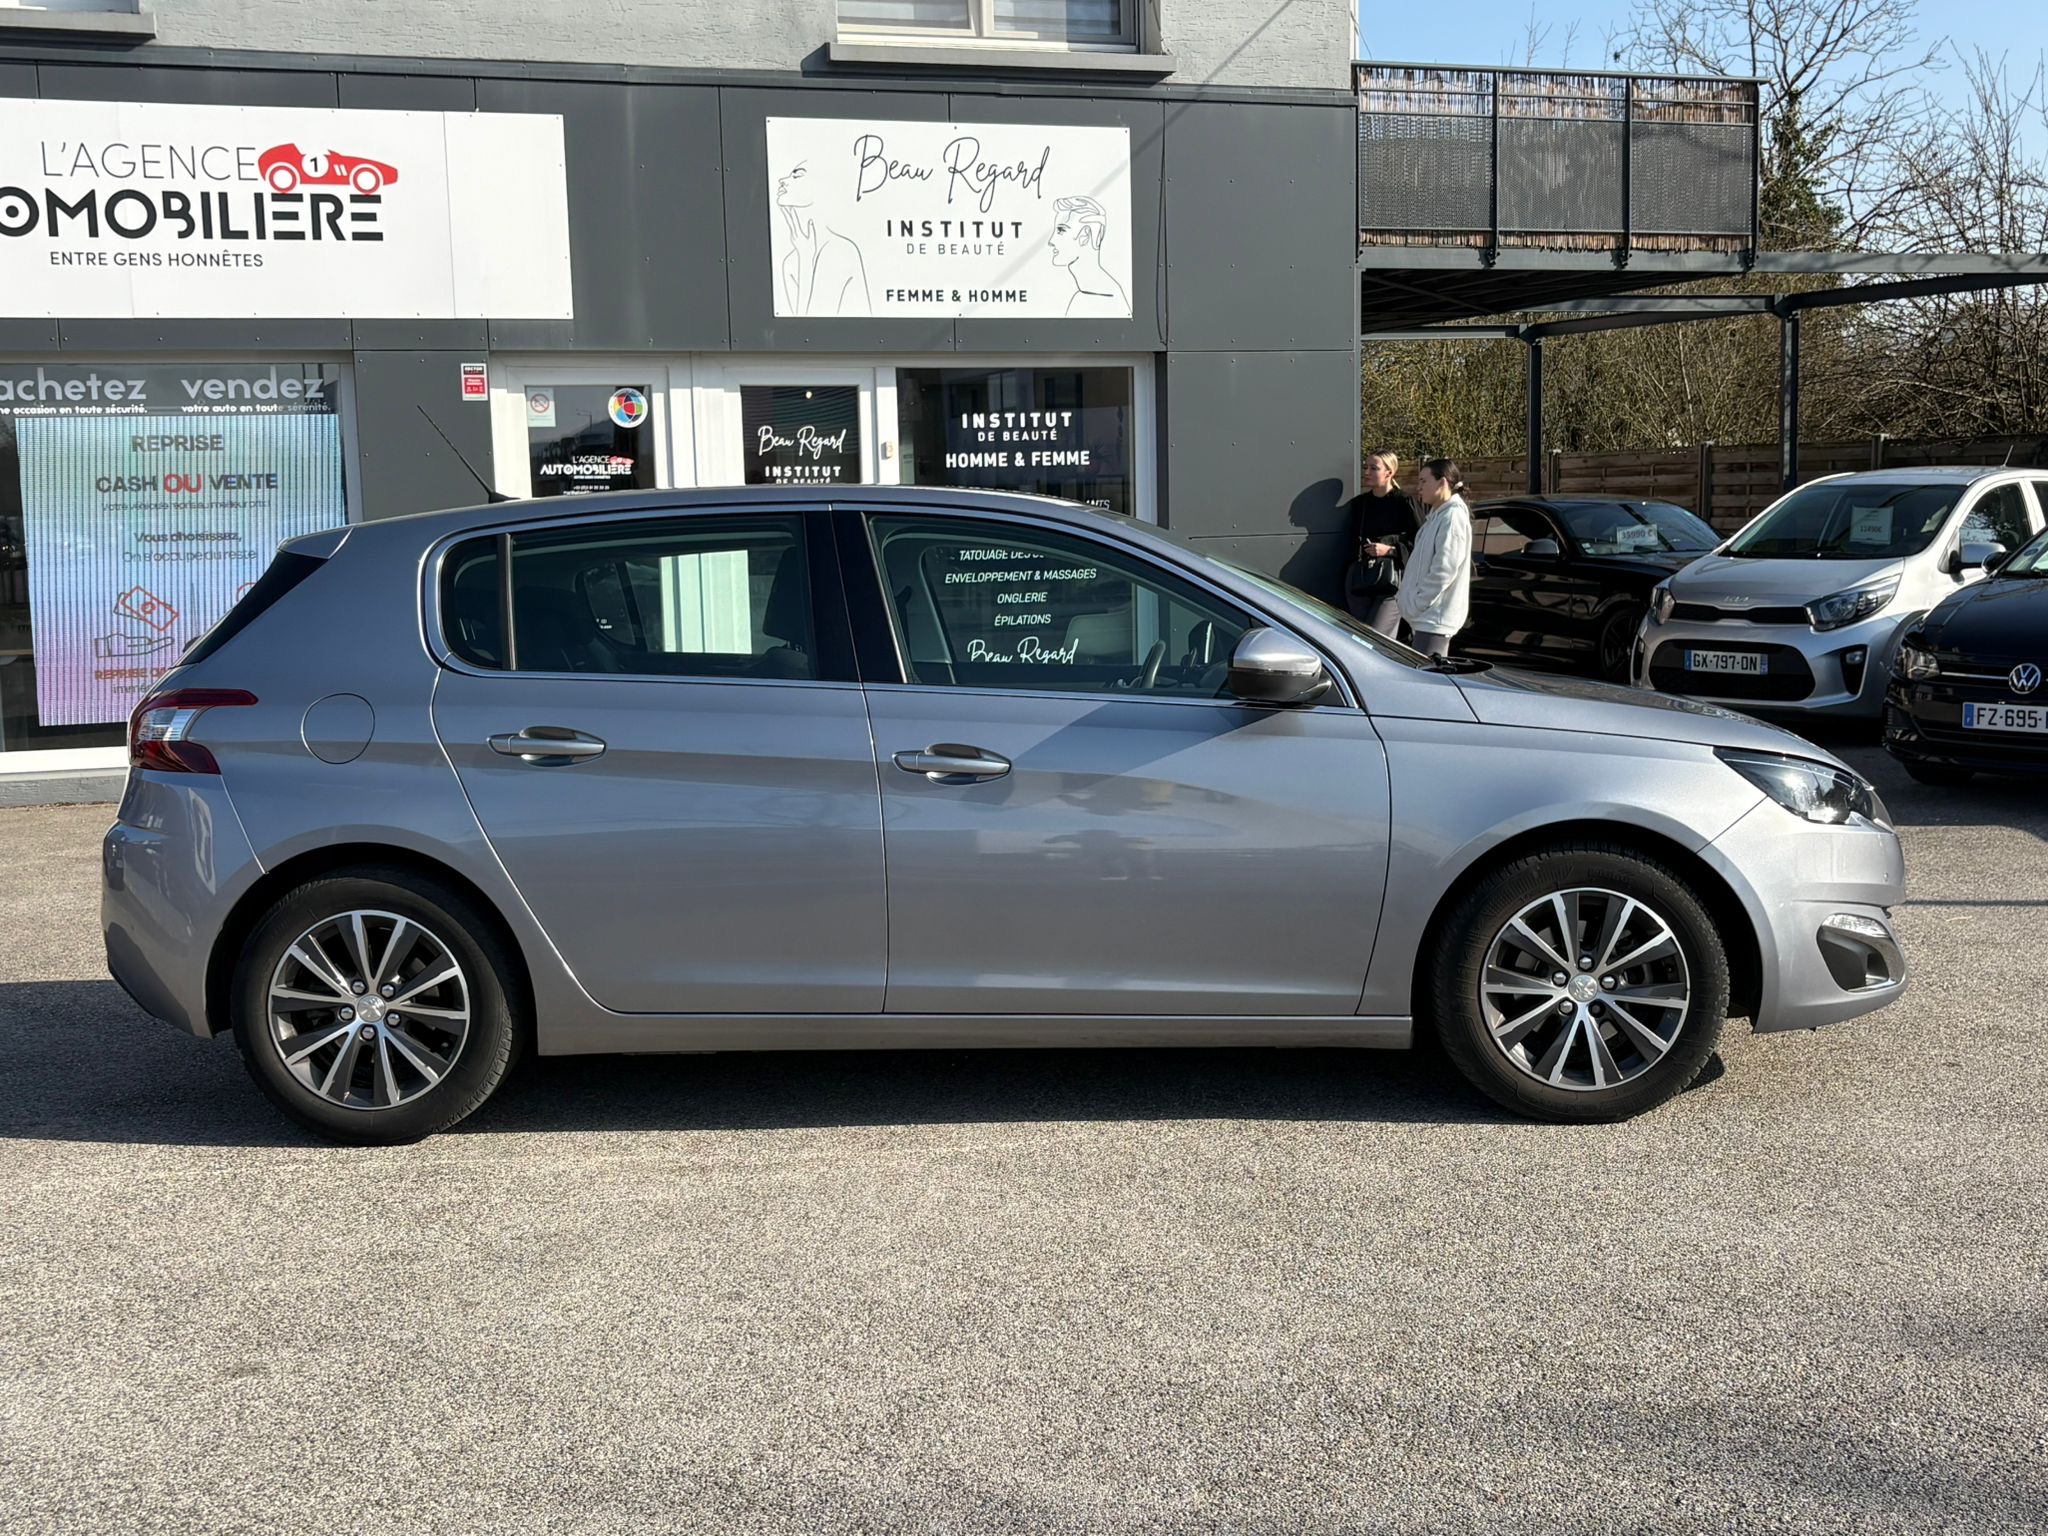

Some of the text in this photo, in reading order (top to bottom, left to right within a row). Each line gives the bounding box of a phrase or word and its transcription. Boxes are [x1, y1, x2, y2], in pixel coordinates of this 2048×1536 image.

[41, 140, 259, 182] L'AGENCE
[310, 157, 318, 172] 1
[853, 134, 1051, 213] Beau Regard
[886, 219, 1023, 239] INSTITUT
[906, 241, 1005, 256] DE BEAUTÉ
[50, 249, 264, 267] ENTRE GENS HONNÊTES
[886, 289, 1028, 303] FEMME & HOMME
[0, 367, 147, 401] achetez
[180, 364, 325, 400] vendez
[13, 404, 57, 415] occasion
[60, 406, 72, 414] en
[75, 405, 102, 414] toute
[105, 403, 148, 414] sécurité.
[181, 402, 332, 413] votre auto en toute sérénité.
[961, 411, 1073, 429] INSTITUT
[132, 434, 224, 452] REPRISE
[758, 425, 847, 460] Beau Regard
[977, 428, 1058, 442] DE BEAUTÉ
[572, 455, 610, 464] L'AGENCE
[945, 450, 1091, 468] HOMME & FEMME
[765, 465, 841, 477] INSTITUT
[95, 473, 278, 493] CASH OU VENTE
[134, 532, 168, 543] Vous
[960, 549, 1009, 561] TATOUAGE
[945, 568, 1097, 584] ENVELOPPEMENT & MASSAGES
[997, 591, 1048, 604] ONGLERIE
[994, 613, 1052, 627] ÉPILATIONS
[967, 636, 1080, 665] Beau Regard
[1693, 653, 1758, 672] GX-797-DN
